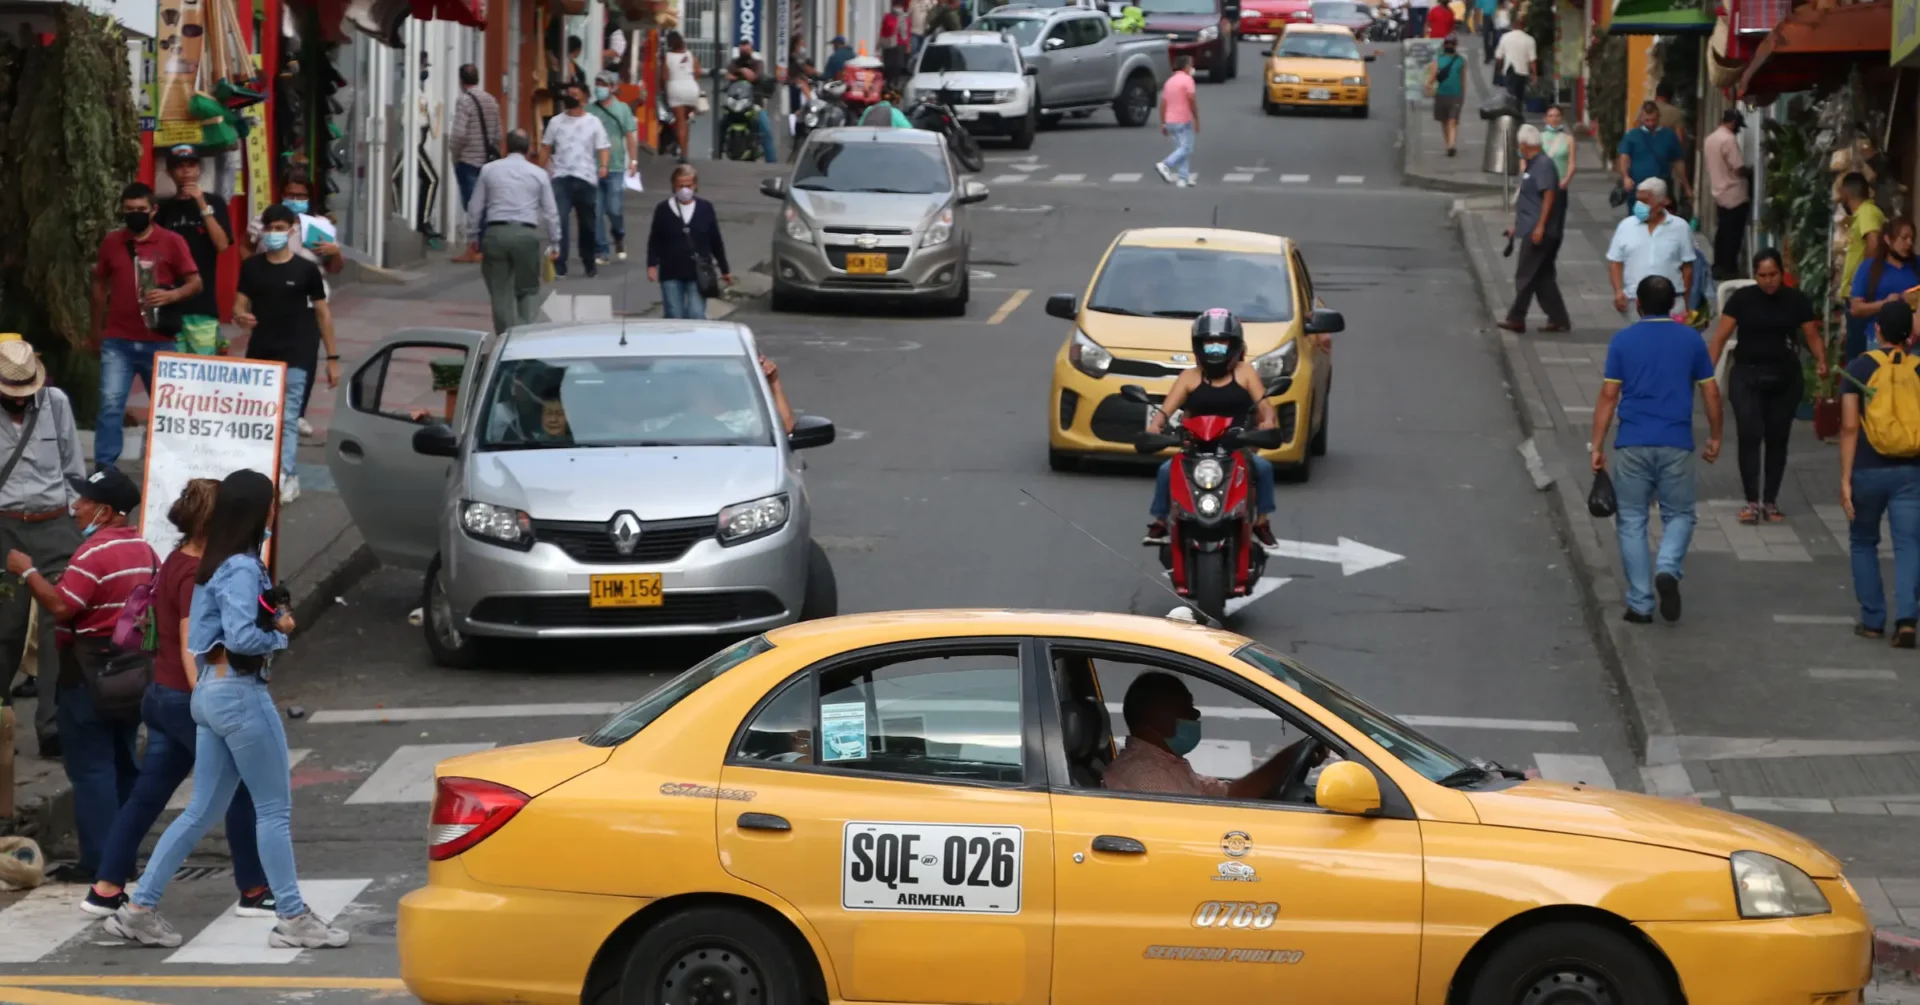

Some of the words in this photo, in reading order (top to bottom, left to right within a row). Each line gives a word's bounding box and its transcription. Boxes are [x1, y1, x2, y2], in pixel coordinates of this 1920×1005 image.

[157, 361, 275, 387] RESTAURANTE
[155, 415, 186, 435] 318
[189, 418, 275, 441] 8574062
[592, 579, 660, 599] IHM-156
[851, 832, 921, 890] SQE
[943, 835, 1015, 888] 026
[897, 893, 966, 907] ARMENIA
[1195, 900, 1280, 929] 0768
[1144, 945, 1228, 961] SERVICIO
